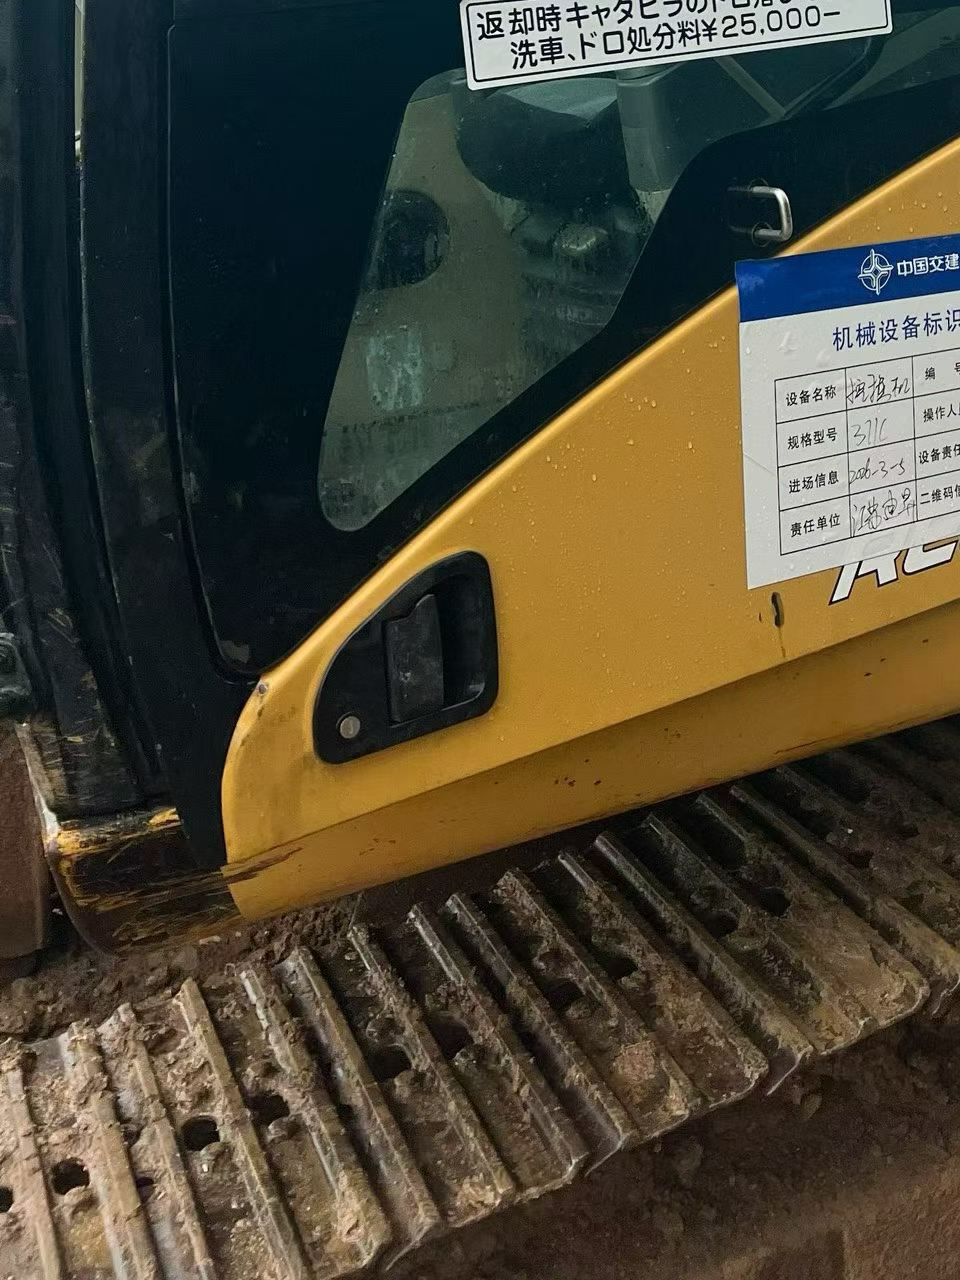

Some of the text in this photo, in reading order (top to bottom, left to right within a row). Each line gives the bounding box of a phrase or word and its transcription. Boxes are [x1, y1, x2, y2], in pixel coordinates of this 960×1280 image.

[897, 252, 960, 277] 中国交建
[785, 384, 837, 407] 设备名称
[787, 427, 838, 450] 规格型号
[788, 470, 839, 493] 进场信息
[790, 513, 841, 537] 责任单位
